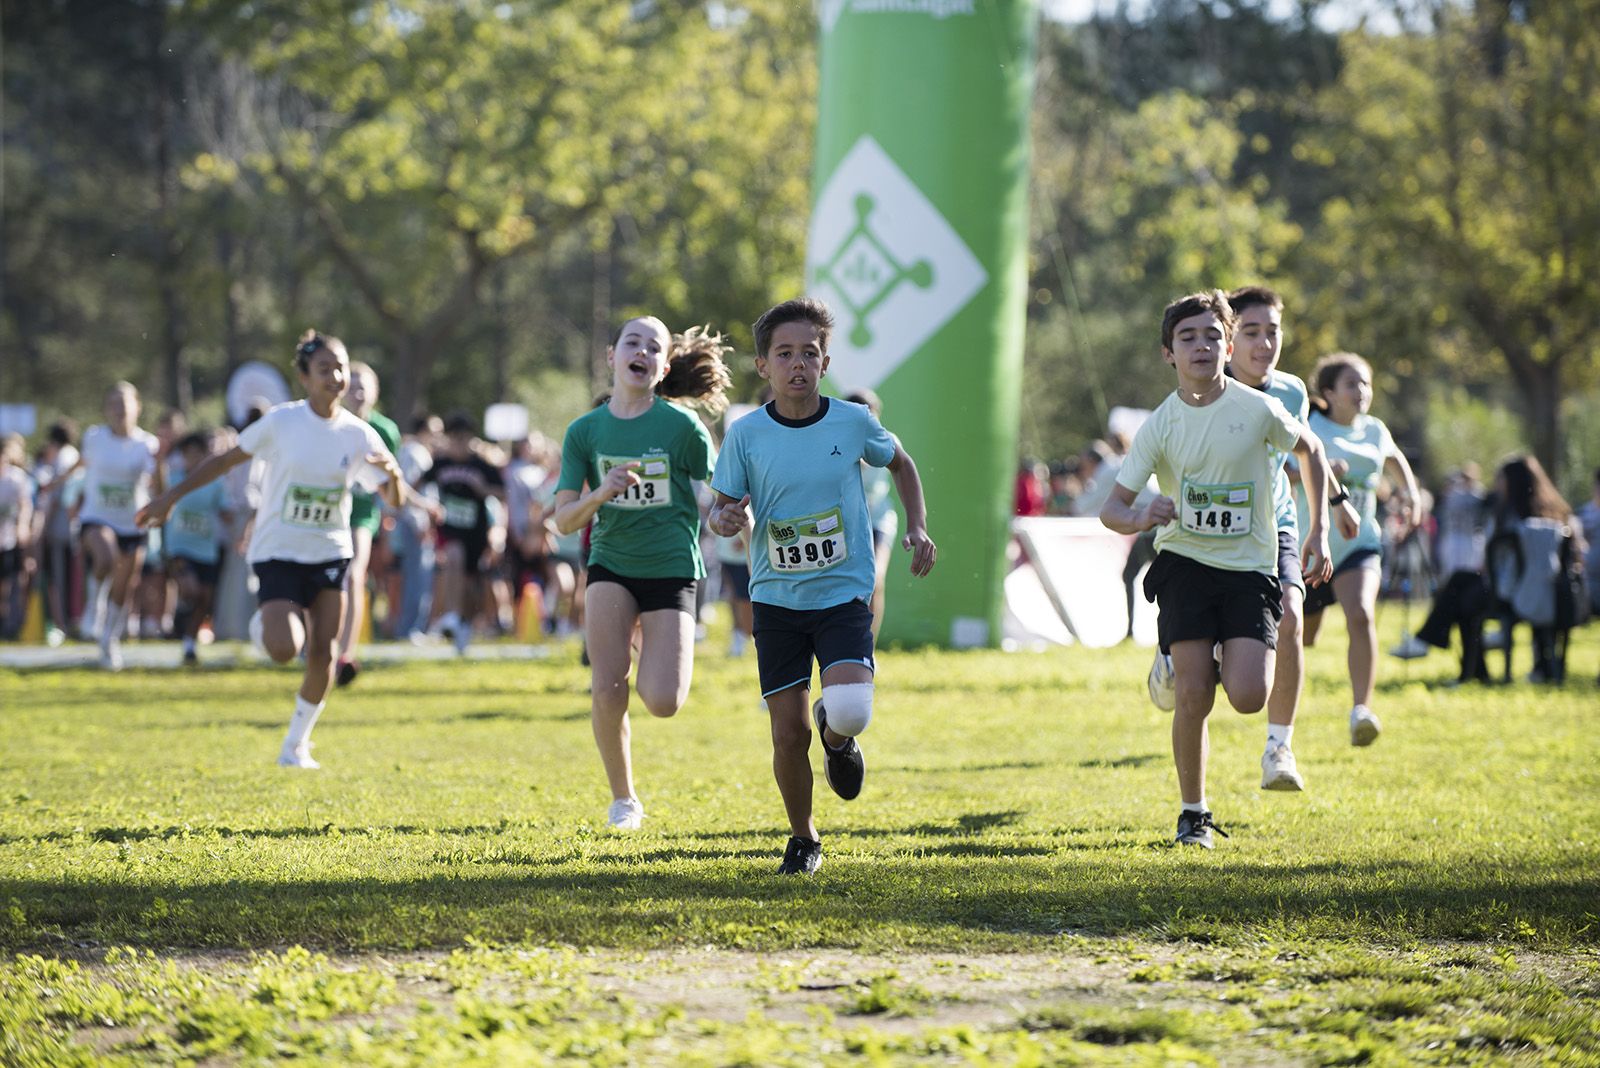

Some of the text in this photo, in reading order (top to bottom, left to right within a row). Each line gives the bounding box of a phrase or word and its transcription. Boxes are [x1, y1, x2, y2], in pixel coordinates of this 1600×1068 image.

[612, 482, 655, 500] 113
[1194, 510, 1232, 528] 148
[775, 538, 834, 564] 1390
